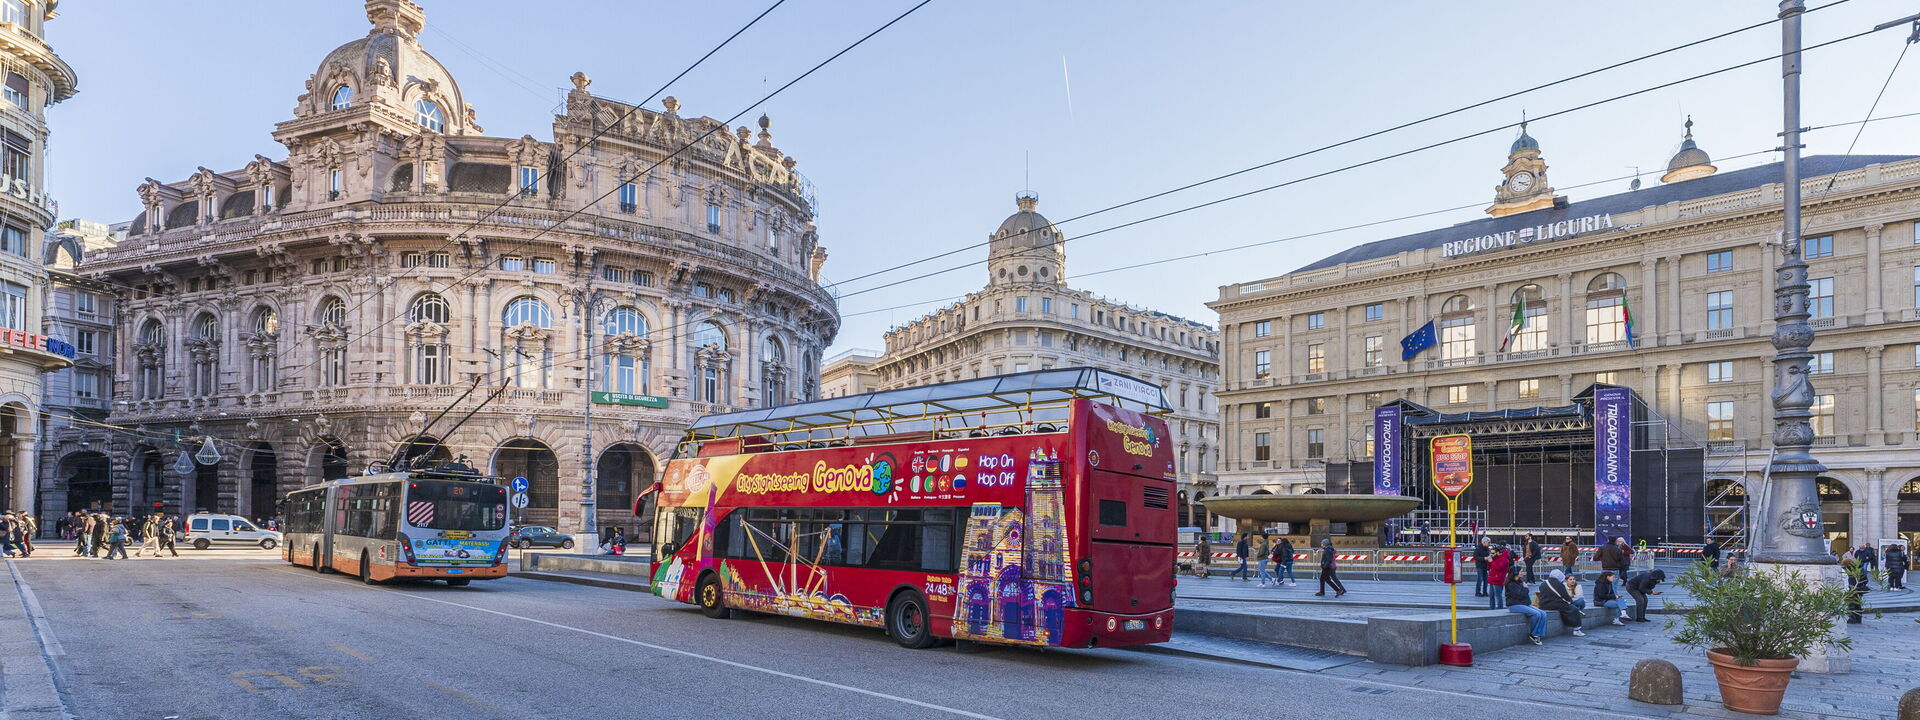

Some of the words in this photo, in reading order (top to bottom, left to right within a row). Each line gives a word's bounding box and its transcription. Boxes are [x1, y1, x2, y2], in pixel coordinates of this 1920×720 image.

[1441, 230, 1516, 257] REGIONE
[1536, 212, 1613, 241] LIGURIA
[1113, 378, 1132, 390] ZANI
[1133, 384, 1158, 398] VIAGGI
[1607, 403, 1618, 483] TRICAPODANNO
[979, 455, 998, 469] Hop
[1000, 453, 1014, 468] On
[1382, 419, 1392, 488] TRICAPODANNO
[737, 472, 810, 495] CitySightseeing
[813, 460, 874, 493] Genova
[977, 473, 997, 487] Hop
[999, 472, 1015, 486] Off
[454, 487, 464, 495] 20
[925, 582, 948, 595] 24/48
